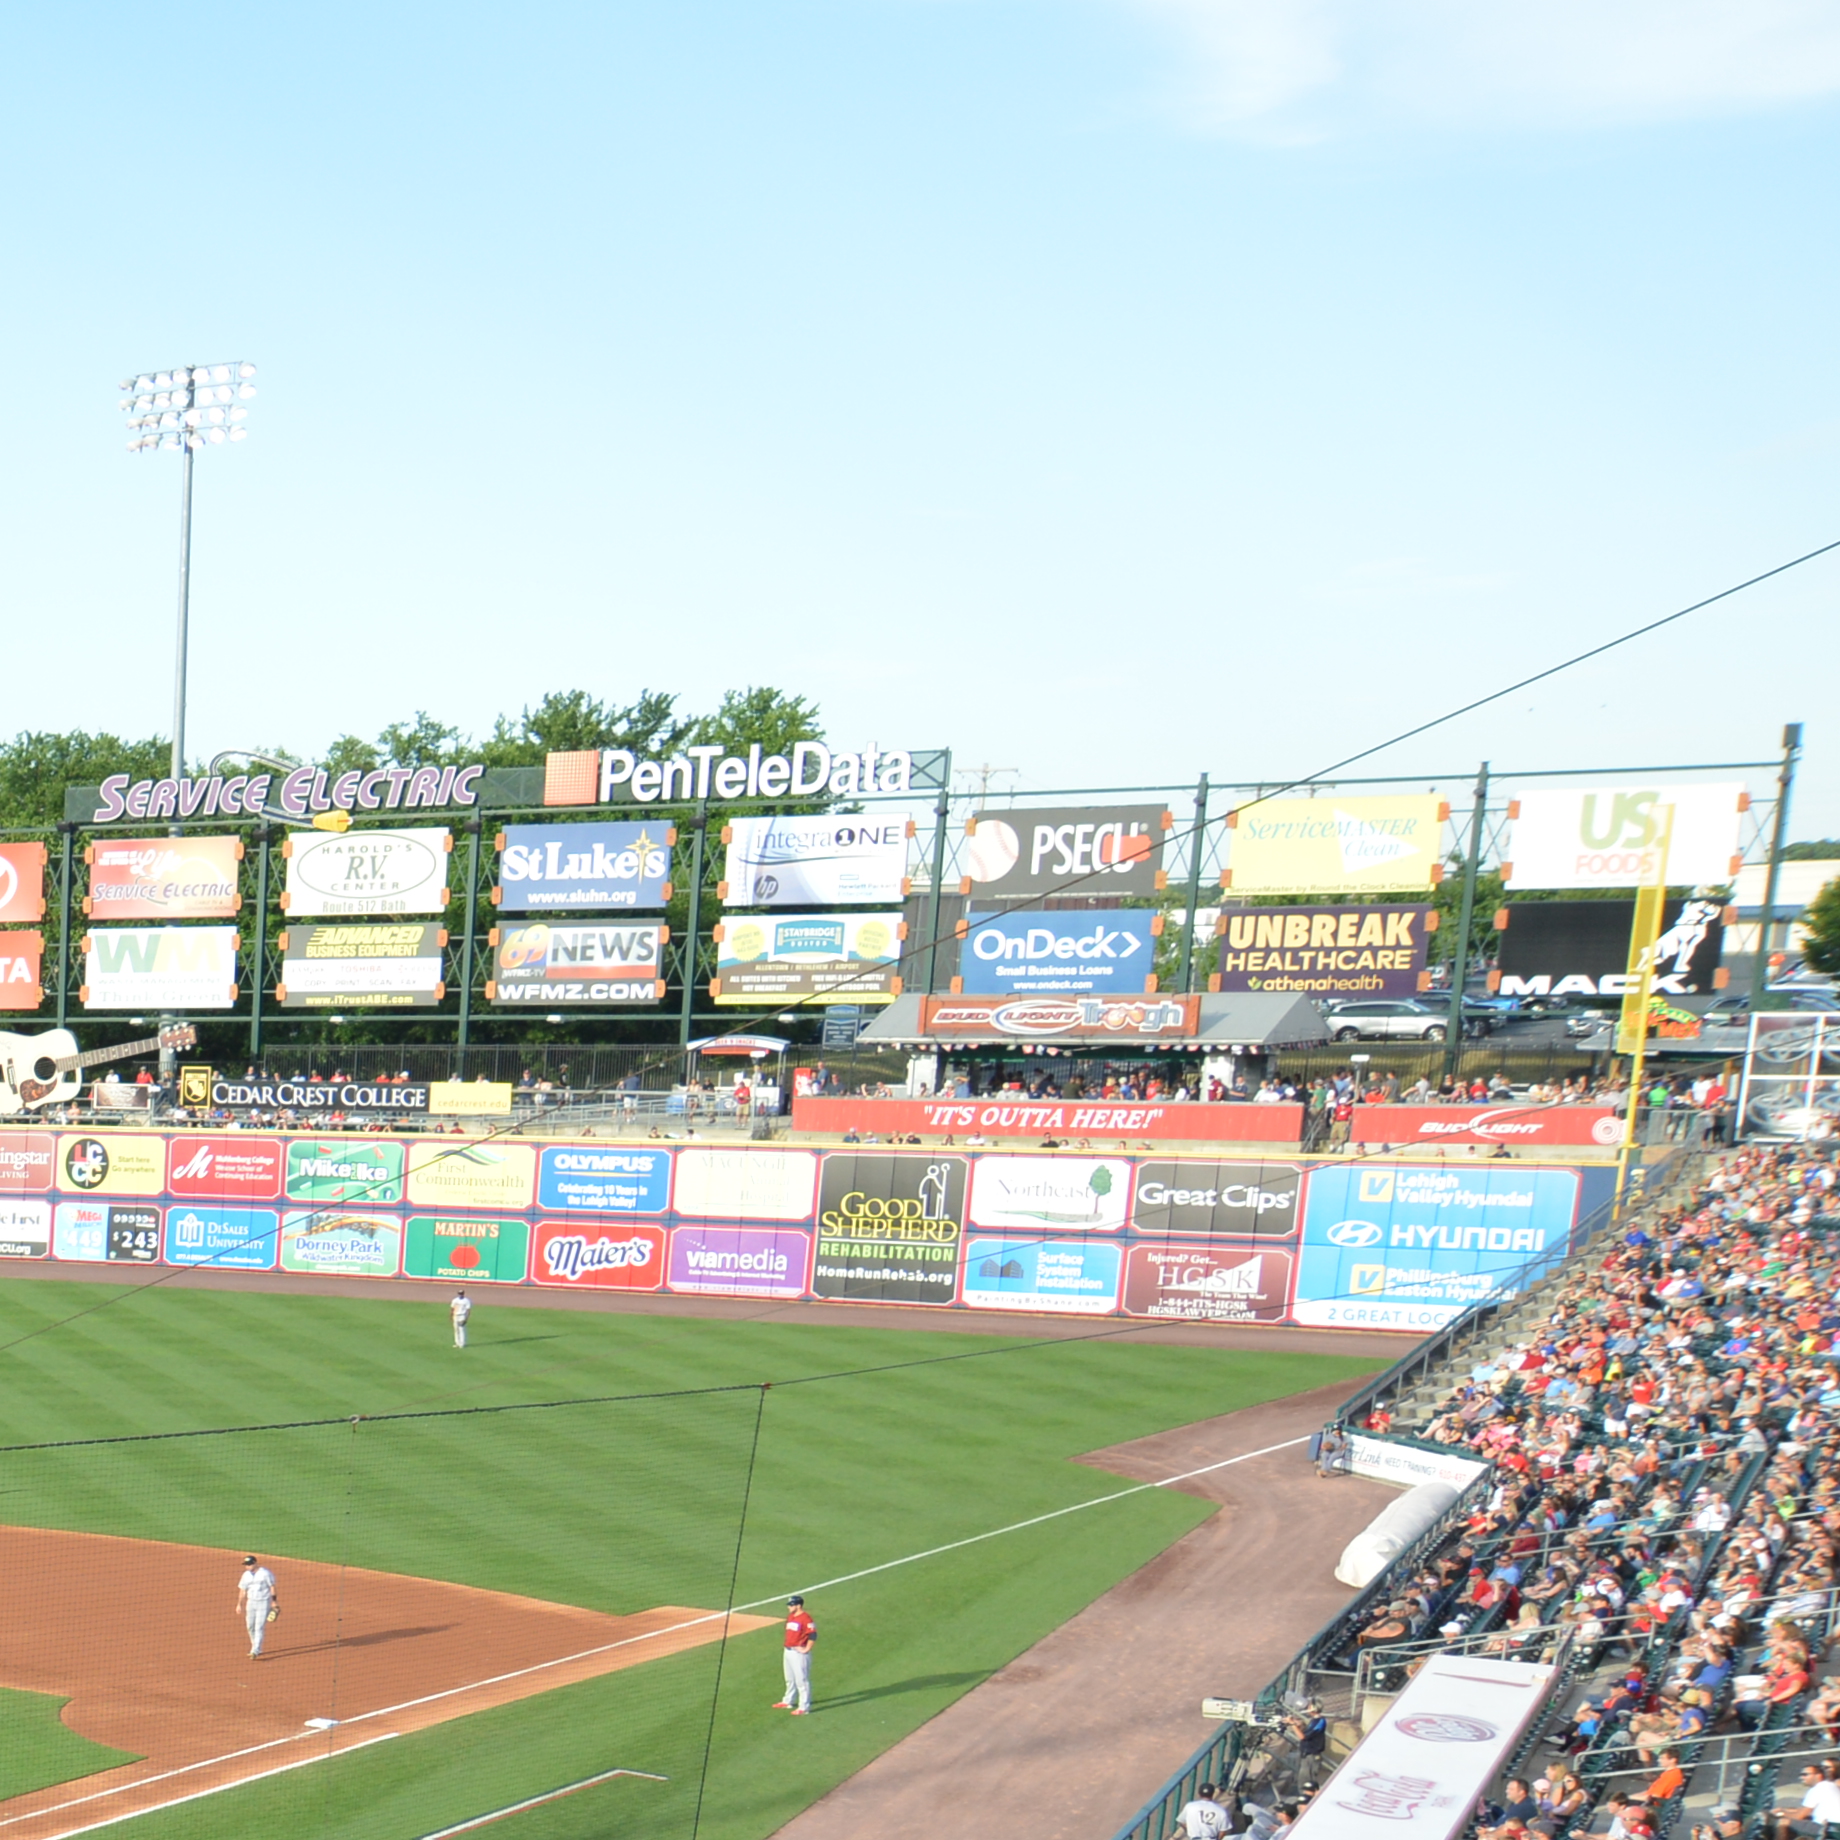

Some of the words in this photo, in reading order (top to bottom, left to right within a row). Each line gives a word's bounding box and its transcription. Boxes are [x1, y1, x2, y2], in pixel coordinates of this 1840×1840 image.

[601, 742, 911, 803] PenTeleData
[94, 774, 271, 822] SERVICE
[281, 765, 484, 813] ELECTRIC
[322, 844, 412, 855] HAROLD'S
[1032, 823, 1139, 875] PSECU
[1344, 839, 1400, 857] Clean
[345, 855, 386, 880] R.V.
[331, 882, 399, 892] CENTER
[322, 901, 352, 914] Route
[357, 900, 376, 913] 512
[381, 900, 406, 913] Bath
[528, 891, 636, 907] www.sluhn.org
[323, 927, 424, 945] ADVANCED
[1229, 912, 1416, 949] UNBREAK
[306, 945, 355, 957] BUSINESS
[358, 945, 419, 957] EQUIPMENT
[500, 925, 549, 968] 69
[551, 927, 656, 961] NEWS
[972, 928, 1119, 960] OnDeck
[1225, 949, 1412, 972] HEALTHCARE
[996, 965, 1024, 976] Small
[1027, 965, 1076, 976] Business
[1079, 964, 1112, 976] Loans
[1262, 974, 1383, 992] athenahealth
[1500, 975, 1690, 996] MACK
[306, 994, 413, 1006] www.iTrustABE.com
[498, 984, 655, 1001] WFMZ.COM
[211, 1081, 277, 1106] CEDAR
[279, 1082, 337, 1107] CREST
[341, 1083, 425, 1109] COLLEGE
[554, 1153, 655, 1172] OLYMPUS
[415, 1173, 525, 1189] Commonwealth
[1396, 1172, 1459, 1190] Lehigh
[840, 1192, 922, 1219] GOOD
[1138, 1182, 1217, 1207] Great
[1221, 1185, 1292, 1214] Clips
[1396, 1188, 1453, 1207] Valley
[1454, 1190, 1534, 1208] Hyundai
[434, 1222, 499, 1238] MARTIN'S
[821, 1211, 958, 1242] SHEPHERD
[296, 1237, 347, 1253] Dorney
[350, 1238, 382, 1254] Park
[1390, 1225, 1546, 1252] HYUNDAI
[686, 1249, 788, 1272] viamedia
[819, 1242, 954, 1262] REHABILITATION
[1037, 1251, 1084, 1265] Surface
[437, 1268, 465, 1277] POTATO
[466, 1269, 491, 1278] CHIPS
[817, 1265, 952, 1286] HomeRunRehab.org
[1036, 1263, 1082, 1278] System
[1385, 1268, 1493, 1290] Phillipsburg
[1035, 1275, 1103, 1290] Installation
[1198, 1809, 1216, 1827] 12
